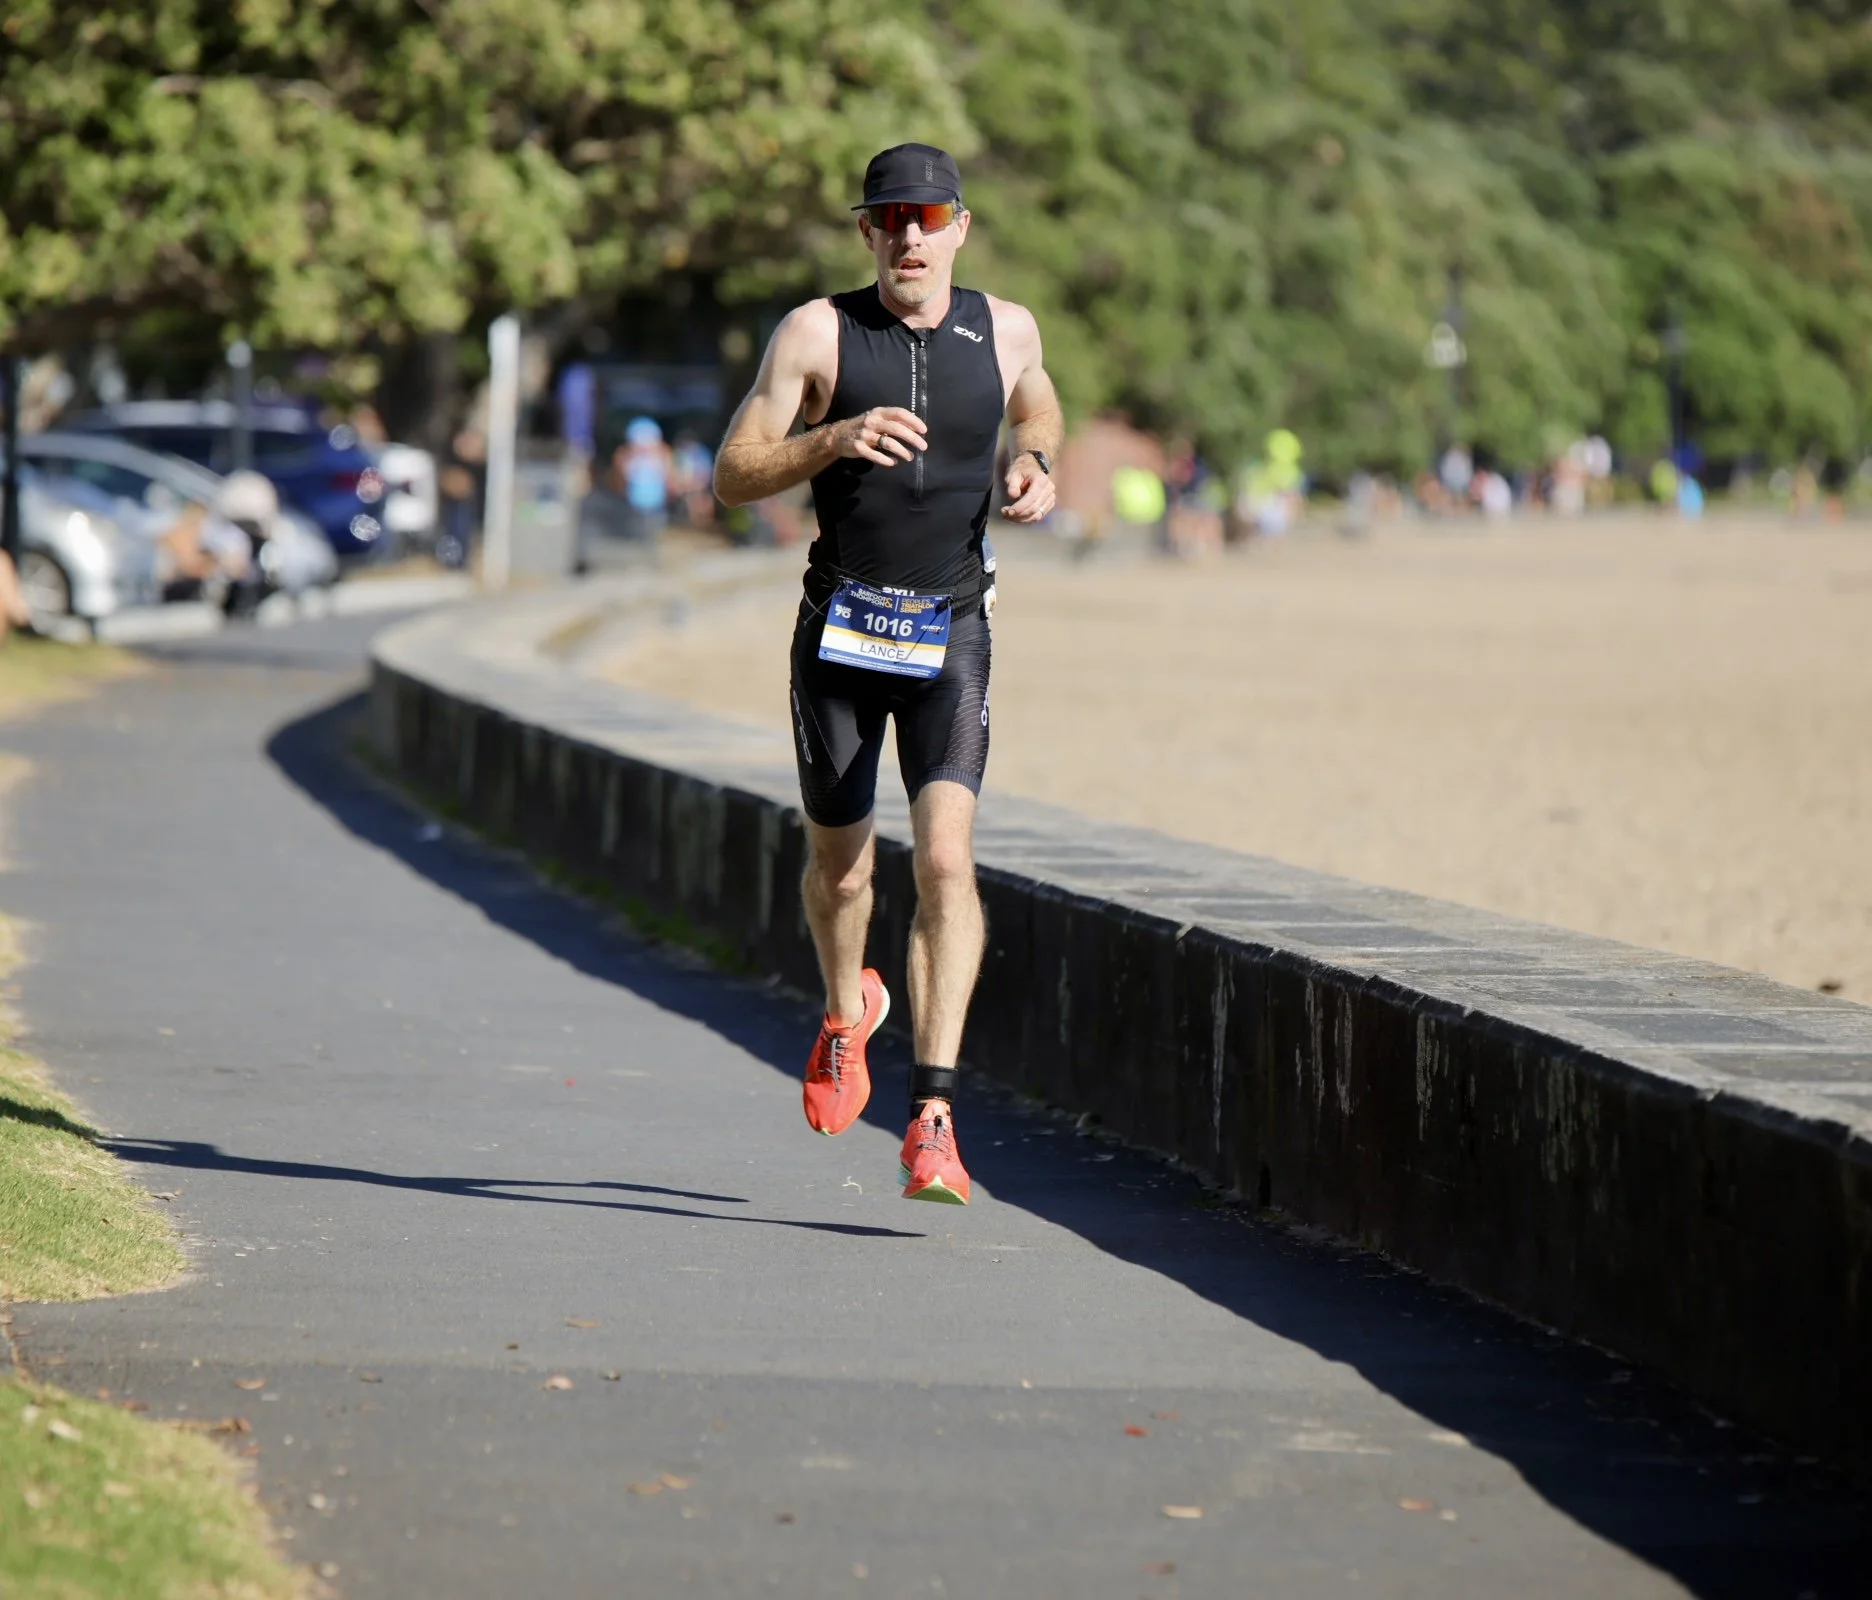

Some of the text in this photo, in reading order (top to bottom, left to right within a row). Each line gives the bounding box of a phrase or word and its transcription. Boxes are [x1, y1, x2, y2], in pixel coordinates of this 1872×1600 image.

[953, 325, 984, 343] 2XU
[850, 590, 886, 607] THOMPSON
[863, 612, 914, 637] 1016
[860, 642, 905, 660] LANCE
